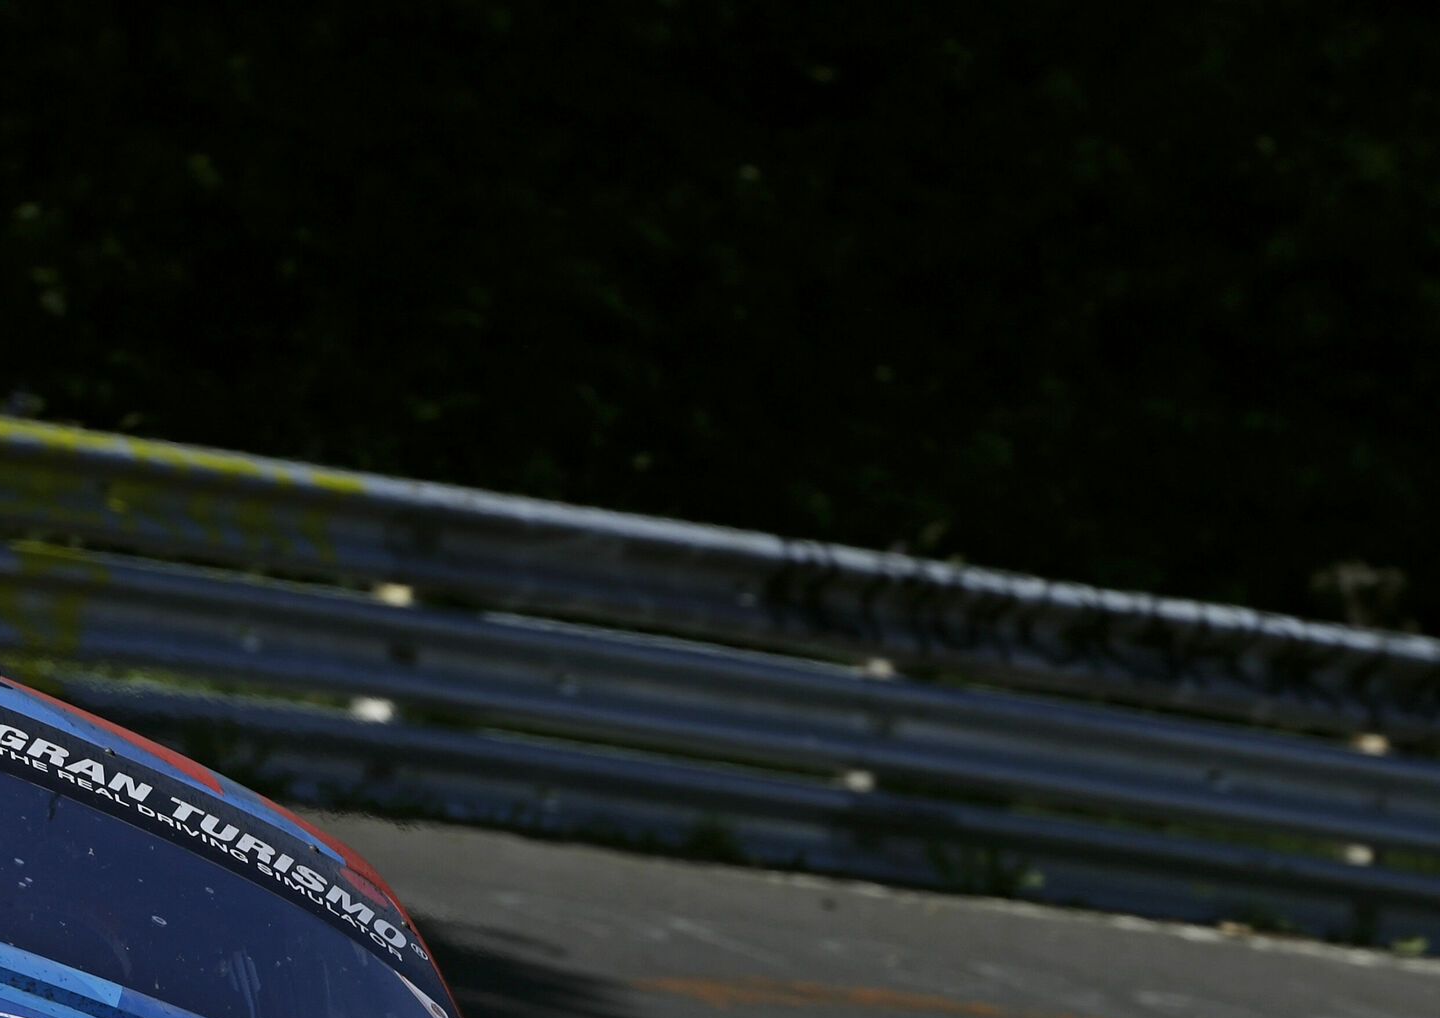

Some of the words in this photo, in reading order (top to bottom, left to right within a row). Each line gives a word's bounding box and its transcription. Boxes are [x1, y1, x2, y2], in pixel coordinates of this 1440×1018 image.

[57, 769, 130, 807] REAL
[137, 803, 249, 864] DRIVING
[257, 862, 403, 962] SIMULATOR
[171, 797, 407, 949] TURISMO
